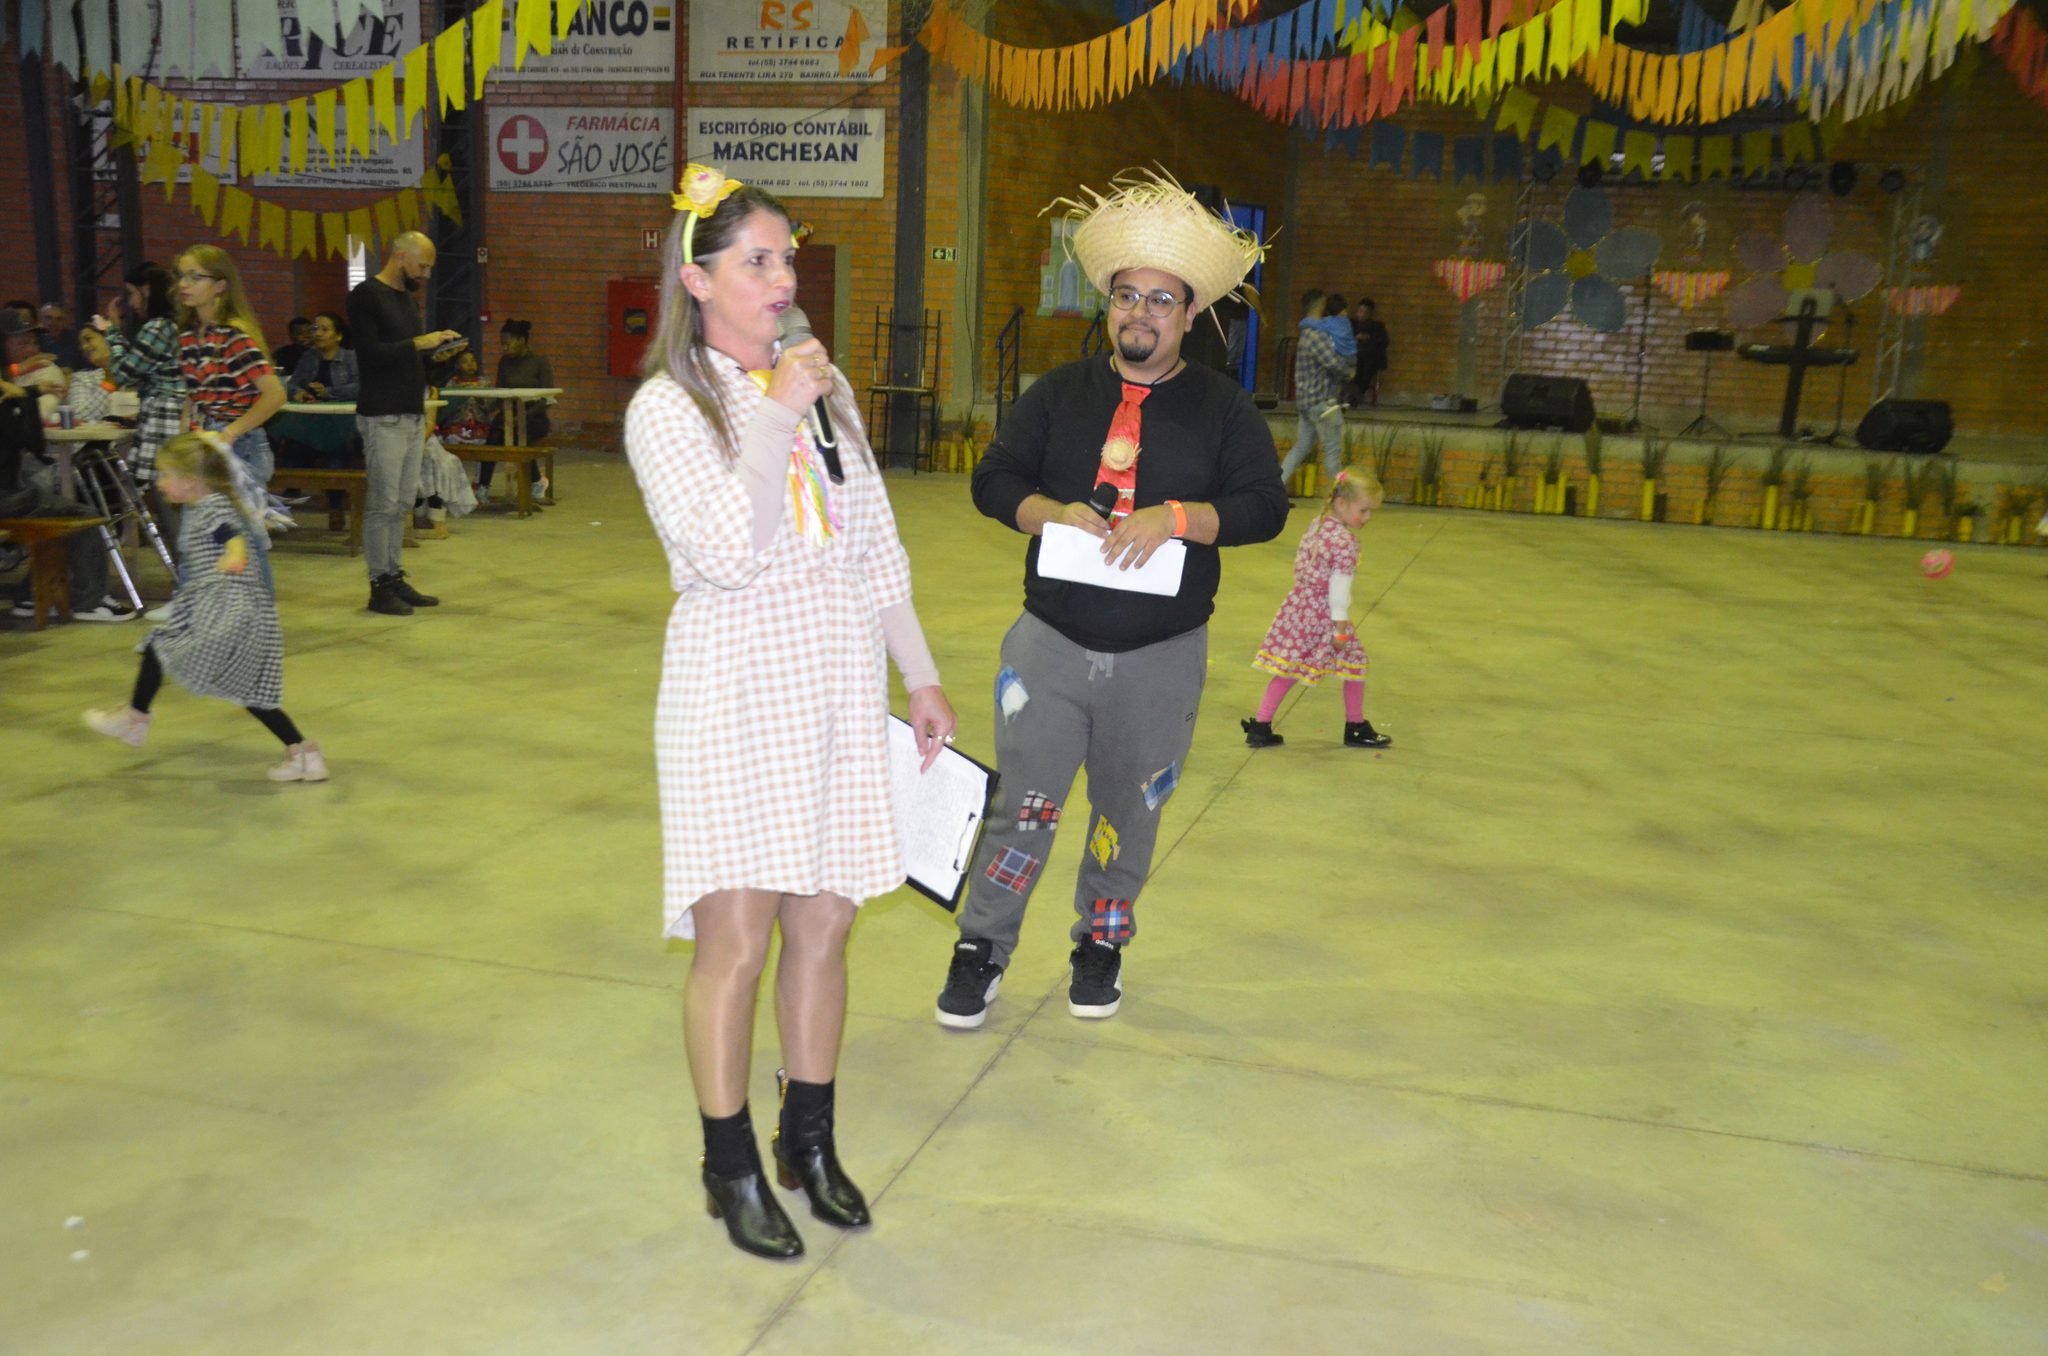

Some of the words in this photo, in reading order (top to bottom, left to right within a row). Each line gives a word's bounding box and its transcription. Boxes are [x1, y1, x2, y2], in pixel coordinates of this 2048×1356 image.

[761, 0, 814, 31] RS
[719, 71, 755, 79] TENENTE
[566, 113, 661, 131] FARMÁCIA
[699, 118, 787, 136] ESCRITÓRIO
[793, 118, 872, 136] CONTÁBIL
[557, 136, 602, 174] SÃO
[609, 136, 668, 173] JOSÉ
[713, 142, 858, 162] MARCHESAN
[646, 231, 658, 248] H
